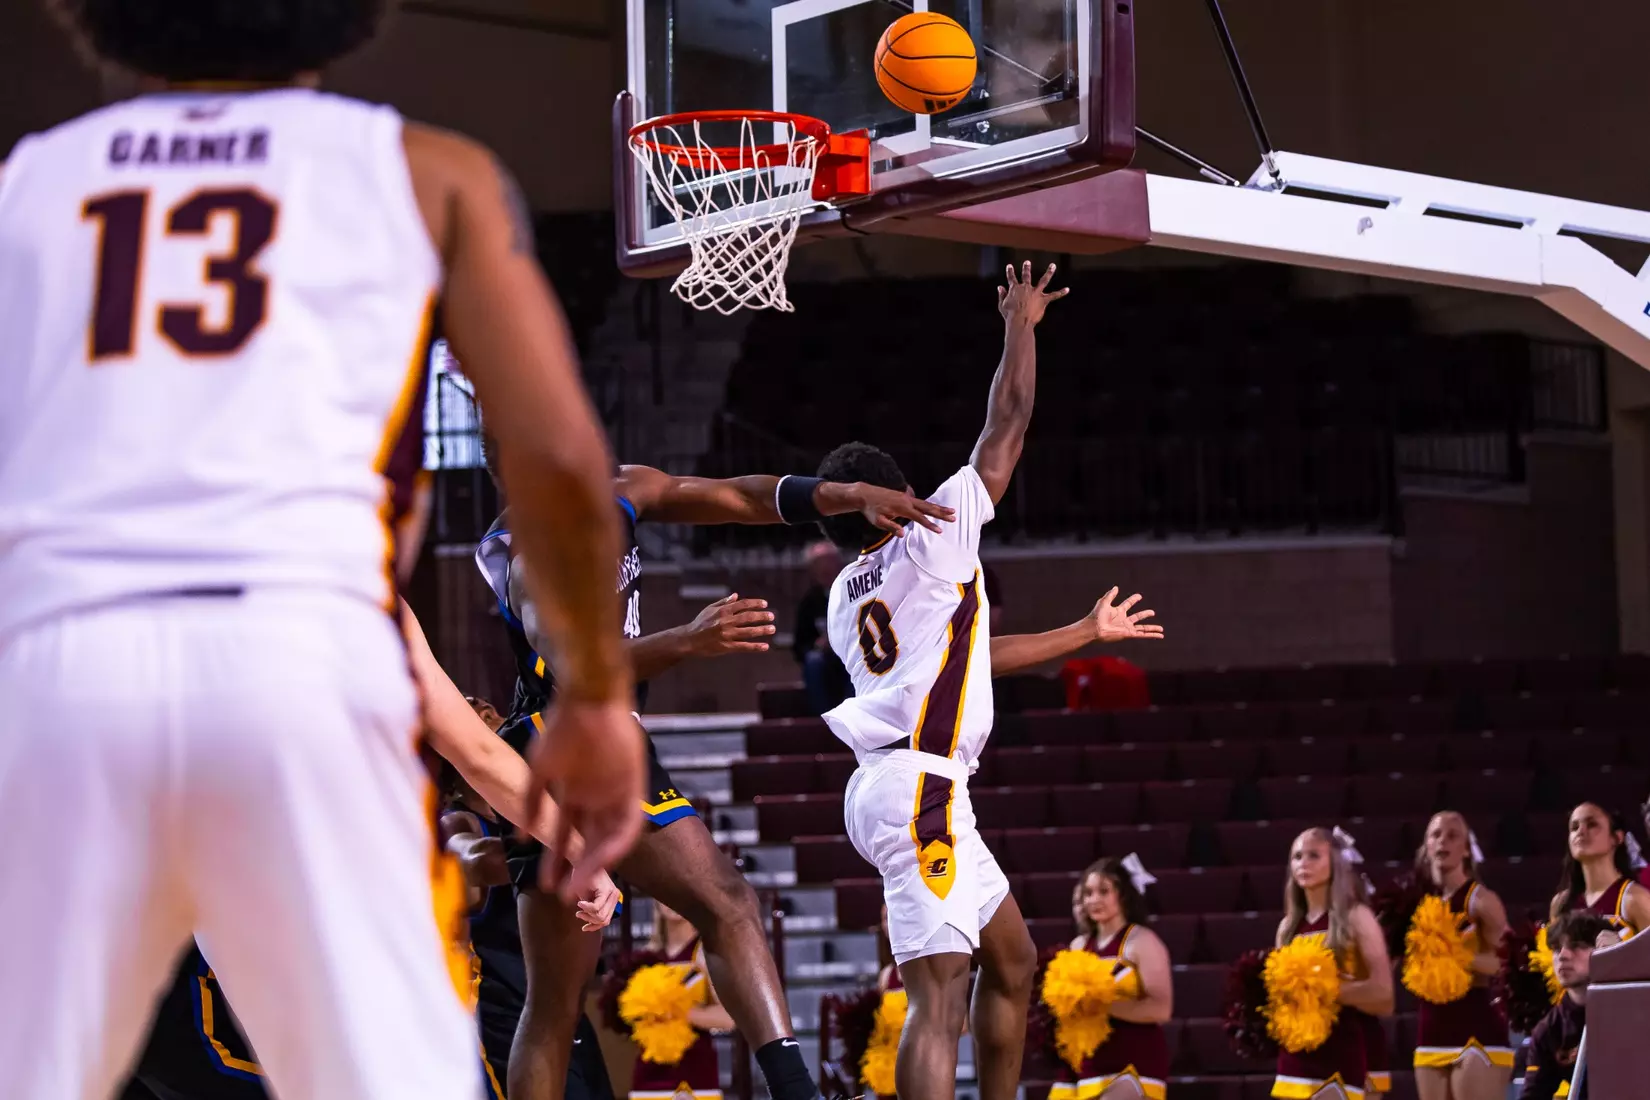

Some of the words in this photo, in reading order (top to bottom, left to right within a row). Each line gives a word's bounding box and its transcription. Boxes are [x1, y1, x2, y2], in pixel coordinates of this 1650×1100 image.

[108, 129, 271, 166] GARNER
[81, 186, 280, 364] 13
[857, 597, 899, 675] 0
